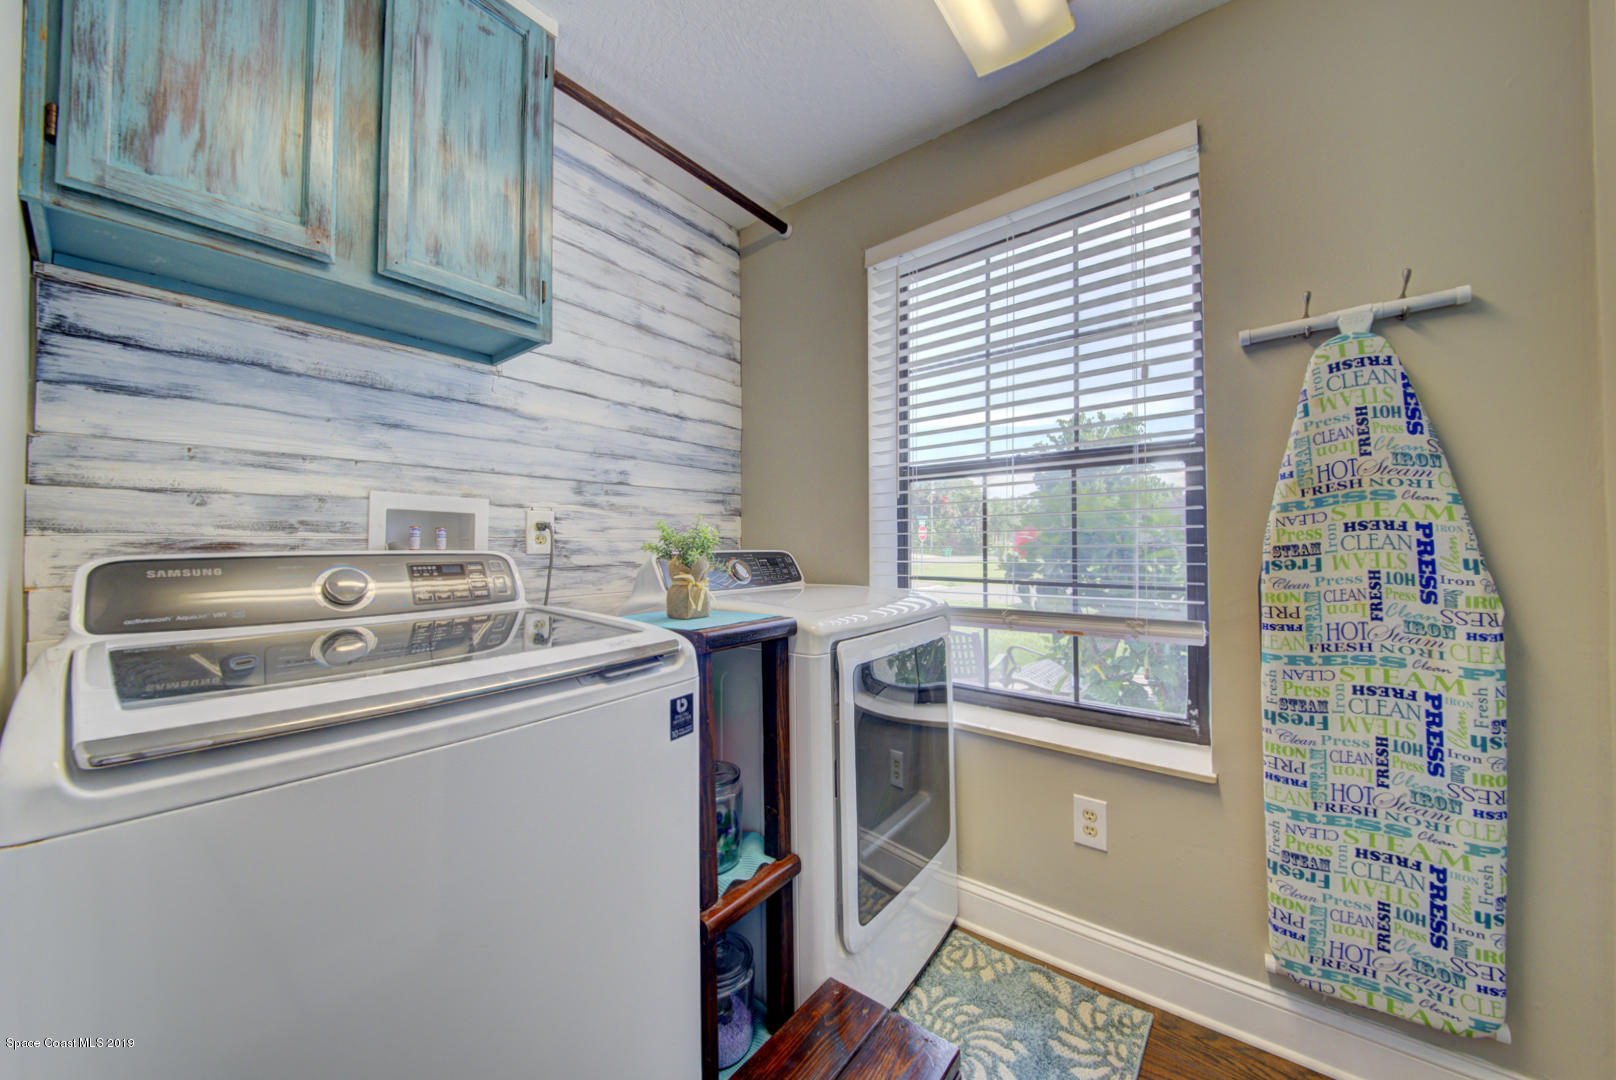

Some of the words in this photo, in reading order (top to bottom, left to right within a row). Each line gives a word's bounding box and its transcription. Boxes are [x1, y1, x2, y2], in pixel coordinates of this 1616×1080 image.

[1328, 355, 1393, 374] FRESH
[1311, 366, 1325, 398] Iron
[1326, 368, 1398, 392] CLEAN
[1319, 386, 1394, 413] STEAM
[1303, 413, 1350, 432] Press
[1371, 405, 1402, 419] HOT
[1312, 424, 1355, 446] CLEAN
[1355, 406, 1372, 457] FRESH
[1372, 421, 1404, 434] Press
[1316, 440, 1356, 457] Iron
[1374, 435, 1426, 452] Clean
[1316, 458, 1358, 483] HOT
[1356, 457, 1434, 478] Steam
[1391, 452, 1442, 468] IRON
[1300, 478, 1363, 498] FRESH
[1368, 478, 1435, 488] IRON
[1272, 489, 1398, 514] RESS
[1400, 489, 1441, 502] Clean
[1275, 512, 1328, 528] CLEAN
[1331, 501, 1456, 522] STEAM
[1276, 528, 1323, 542] Press
[1343, 520, 1408, 532] FRESH
[1325, 523, 1338, 554] Iron
[1341, 533, 1412, 551] CLEAN
[1272, 542, 1322, 558] STEAM
[1332, 552, 1408, 571] STEAM
[1415, 522, 1438, 605] PRESS
[146, 568, 223, 578] SAMSUNG
[1314, 576, 1363, 587] Press
[1384, 571, 1416, 587] HOT
[1440, 574, 1476, 587] Iron
[1324, 588, 1367, 603] CLEAN
[1368, 570, 1384, 622] FRESH
[1385, 587, 1418, 602] Press
[1326, 603, 1368, 618] Iron
[1385, 602, 1440, 622] Clean
[1262, 623, 1304, 632] FRESH
[1326, 621, 1369, 642] HOT
[1367, 624, 1448, 649] Steam
[1403, 620, 1457, 640] IRON
[1308, 642, 1373, 653] FRESH
[1380, 643, 1445, 660] IRON
[1261, 652, 1408, 668] PRESS
[1412, 659, 1452, 674] Clean
[1282, 669, 1336, 682] CLEAN
[1340, 667, 1468, 697] STEAM
[1266, 670, 1278, 704] Fresh
[1283, 680, 1330, 698] Press
[1352, 684, 1418, 702] FRESH
[1279, 698, 1329, 714] STEAM
[1332, 684, 1346, 714] Iron
[1472, 688, 1489, 728] Fresh
[1264, 709, 1329, 730] Fresh
[1348, 698, 1422, 722] CLEAN
[1274, 728, 1316, 746] Clean
[1340, 716, 1417, 740] STEAM
[1424, 692, 1445, 778] PRESS
[1265, 740, 1307, 760] IRON
[1321, 734, 1370, 748] Press
[1392, 739, 1424, 758] HOT
[1330, 750, 1374, 765] CLEAN
[1376, 736, 1390, 789] FRESH
[1392, 755, 1425, 774] Press
[1448, 748, 1482, 764] Iron
[1265, 771, 1308, 788] FRESH
[1332, 765, 1374, 784] Iron
[1392, 772, 1446, 795] Clean
[1330, 782, 1374, 806] HOT
[1409, 790, 1464, 815] IRON
[1314, 802, 1378, 818] FRESH
[1372, 792, 1454, 822] Steam
[1264, 802, 1413, 838] PRESS
[1385, 811, 1452, 834] IRON
[1268, 820, 1280, 856] Fresh
[1286, 822, 1339, 841] CLEAN
[1418, 831, 1458, 848] Clean
[1286, 834, 1334, 857] Press
[1344, 828, 1472, 872] STEAM
[1282, 850, 1331, 872] STEAM
[1334, 844, 1348, 875] Iron
[1355, 848, 1422, 872] FRESH
[1268, 858, 1330, 889] Fresh
[1352, 860, 1425, 892] CLEAN
[1341, 876, 1420, 909] STEAM
[1478, 864, 1494, 906] Fresh
[1322, 892, 1372, 912] Press
[1430, 864, 1448, 951] PRESS
[1330, 908, 1375, 928] CLEAN
[1377, 900, 1391, 954] FRESH
[1394, 906, 1426, 928] HOT
[1332, 924, 1374, 946] Iron
[1394, 922, 1428, 943] Press
[1452, 922, 1486, 940] Iron
[1329, 940, 1375, 967] HOT
[1394, 938, 1450, 969] Clean
[1310, 955, 1376, 979] FRESH
[1372, 956, 1454, 995] Steam
[1411, 957, 1467, 990] IRON
[1384, 974, 1457, 1008] IRON
[1340, 985, 1474, 1038] STEAM
[1418, 999, 1462, 1022] Clean
